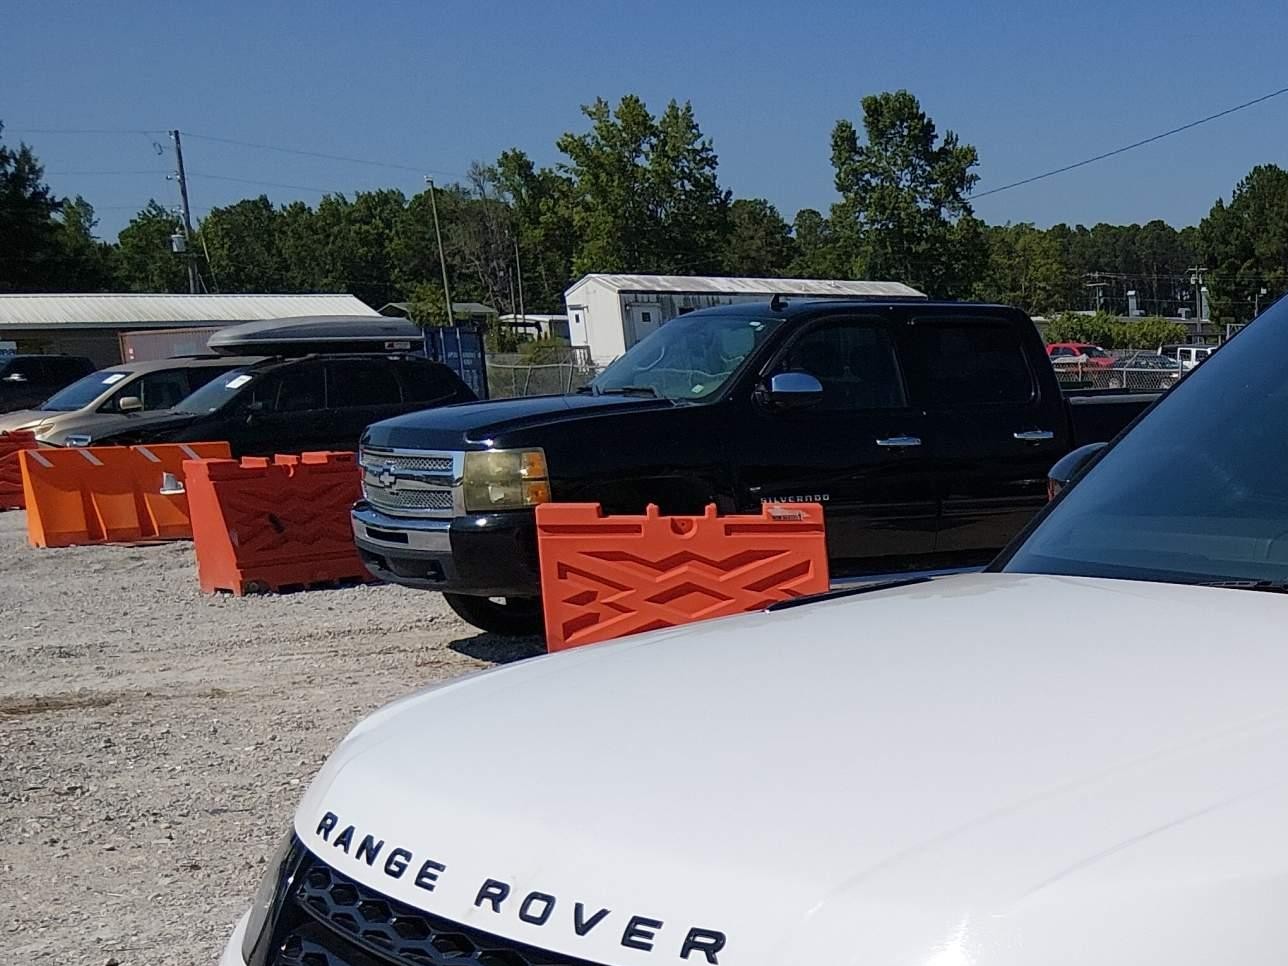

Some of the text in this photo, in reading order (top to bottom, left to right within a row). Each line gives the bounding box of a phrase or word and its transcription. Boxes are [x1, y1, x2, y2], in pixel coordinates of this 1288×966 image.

[760, 494, 830, 504] SILVERADO
[316, 811, 727, 965] RANGE ROVER
